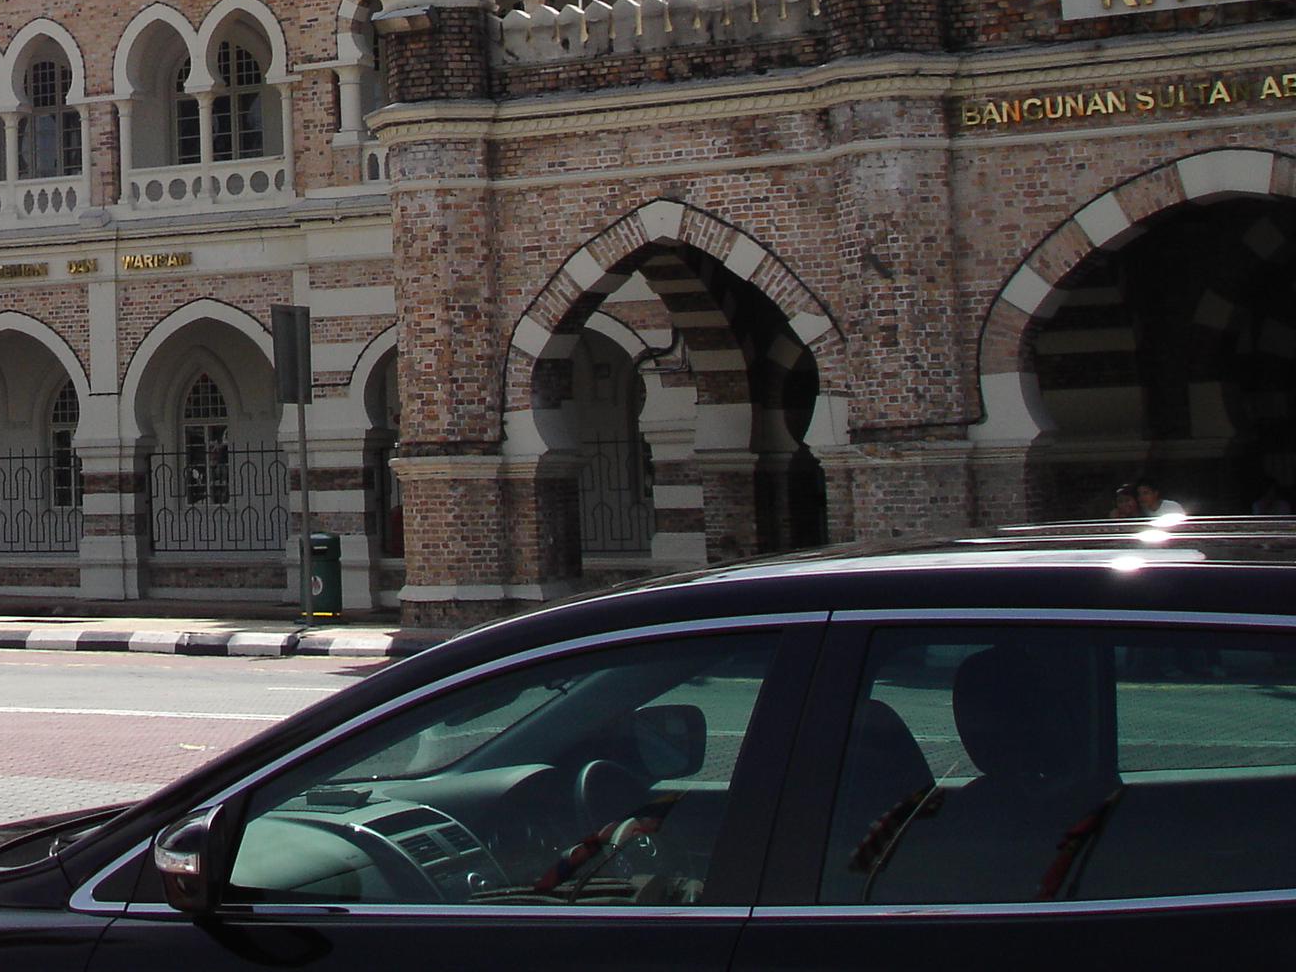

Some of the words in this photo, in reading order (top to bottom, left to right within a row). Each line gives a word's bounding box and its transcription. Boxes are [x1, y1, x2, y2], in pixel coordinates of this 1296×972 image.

[961, 90, 1127, 127] BANGUNAN
[1135, 80, 1252, 111] SULTAN
[121, 251, 193, 270] WARISAN
